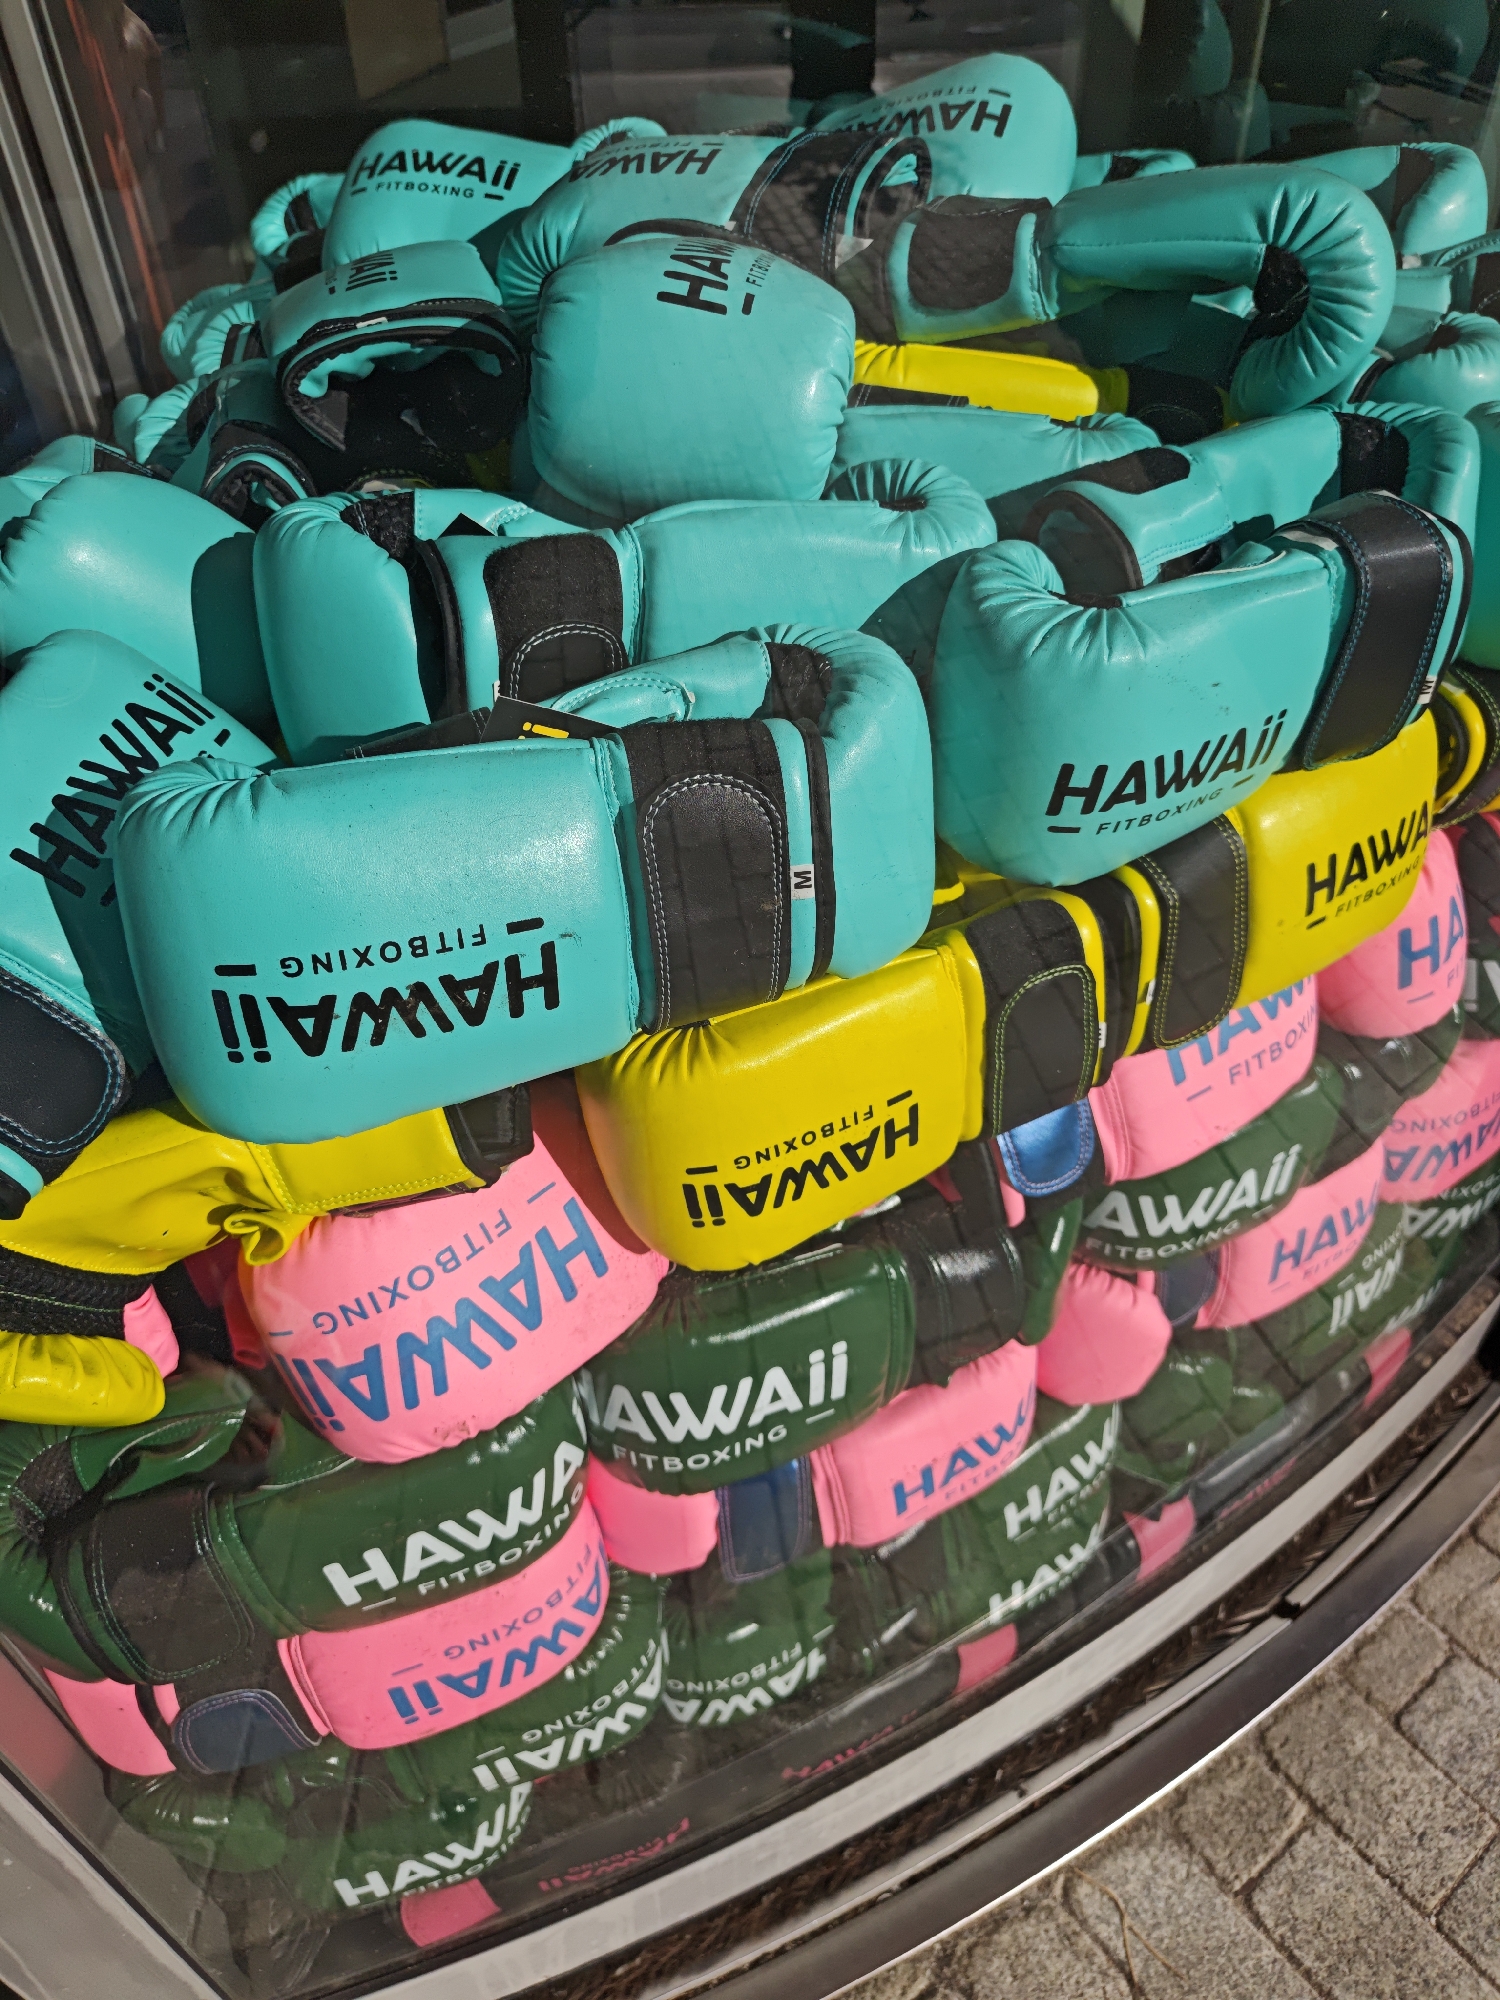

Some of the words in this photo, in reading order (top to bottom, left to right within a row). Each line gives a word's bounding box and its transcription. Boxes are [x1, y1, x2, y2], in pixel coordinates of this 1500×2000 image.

[352, 149, 521, 191] HAWAii
[375, 181, 475, 199] FITBOXING
[9, 673, 216, 898] HAWAii
[1045, 708, 1288, 817] HAWAii
[1096, 788, 1224, 835] FITBOXING
[793, 870, 813, 890] M
[211, 940, 561, 1063] HAWAii
[280, 924, 487, 978] FITBOXING
[682, 1102, 919, 1228] HAWAii
[733, 1104, 874, 1170] FITBOXING
[312, 1208, 513, 1335] FITBOXING
[1085, 1220, 1240, 1261] FITBOXING
[275, 1196, 609, 1432] HAWAii
[613, 1424, 788, 1473] FITBOXING
[418, 1482, 584, 1595] FITBOXING
[443, 1543, 591, 1660] FITBOXING
[521, 1638, 657, 1744] FITBOXING
